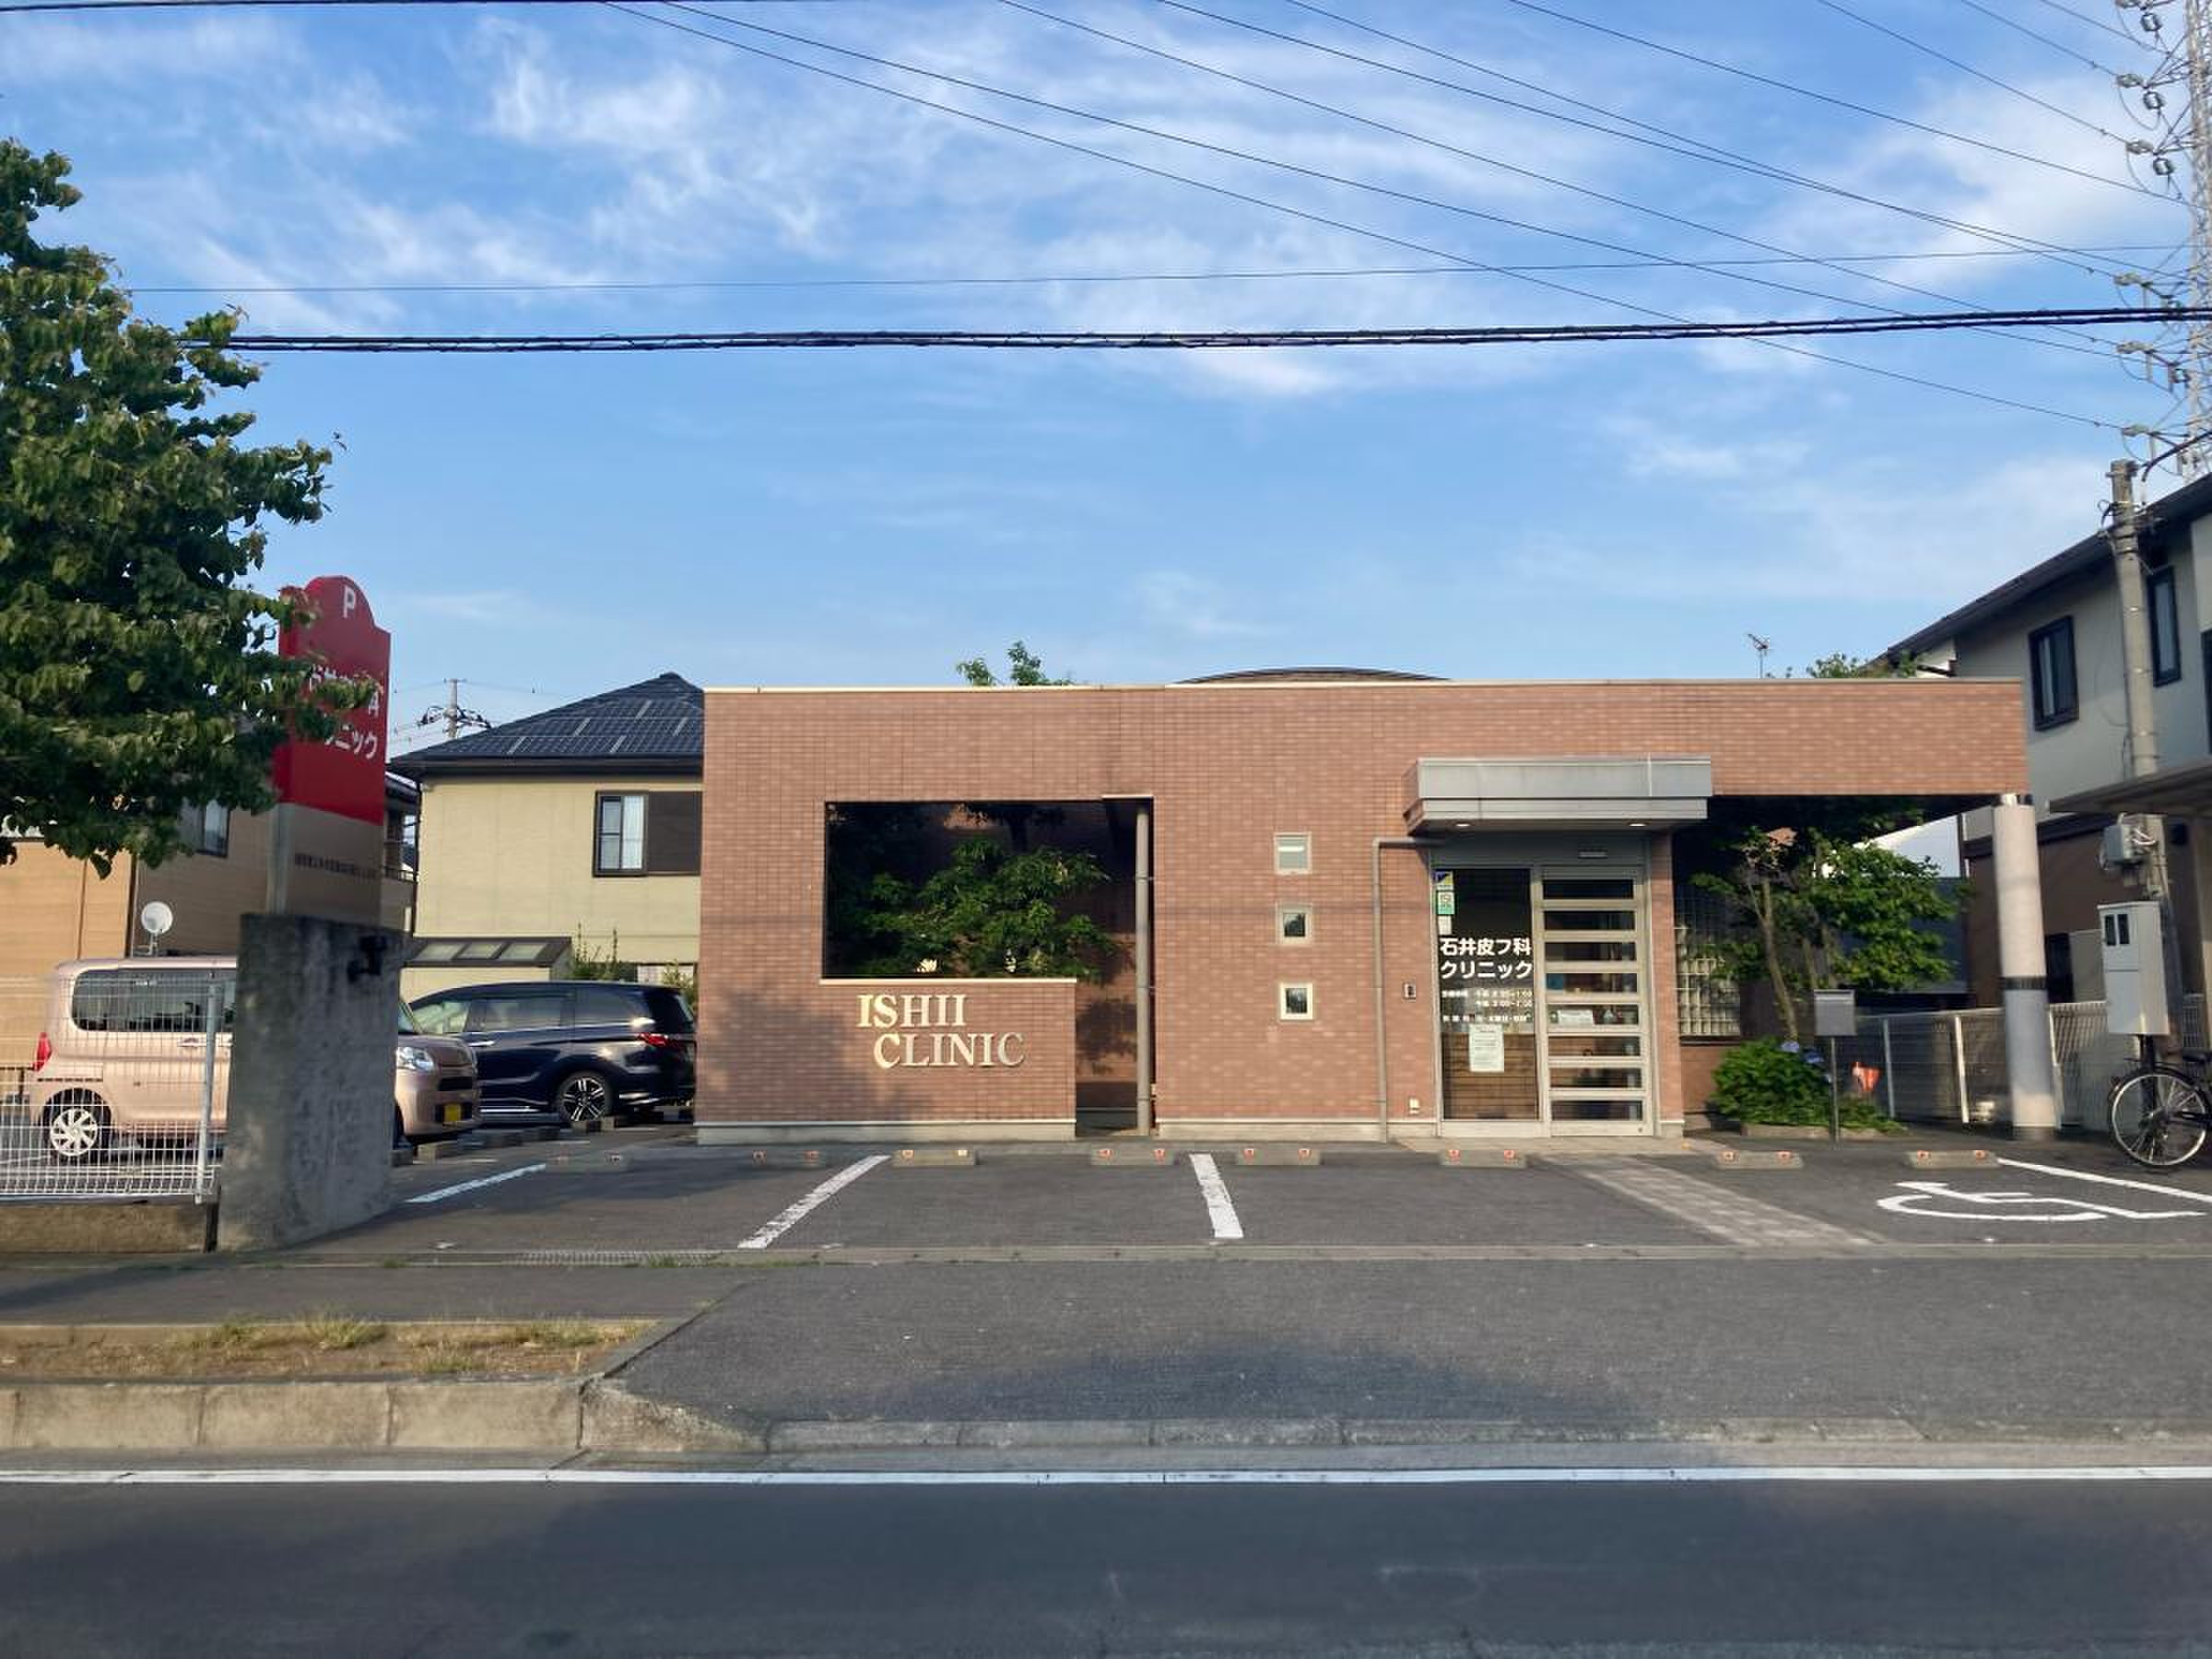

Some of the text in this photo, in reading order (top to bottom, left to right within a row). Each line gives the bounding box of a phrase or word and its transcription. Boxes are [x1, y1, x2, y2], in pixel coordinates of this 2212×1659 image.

[343, 584, 357, 618] P
[1440, 937, 1532, 956] 石井皮フ科
[1441, 960, 1533, 979] クリニック
[856, 994, 967, 1028] ISHII
[874, 1032, 1025, 1068] CLINIC
